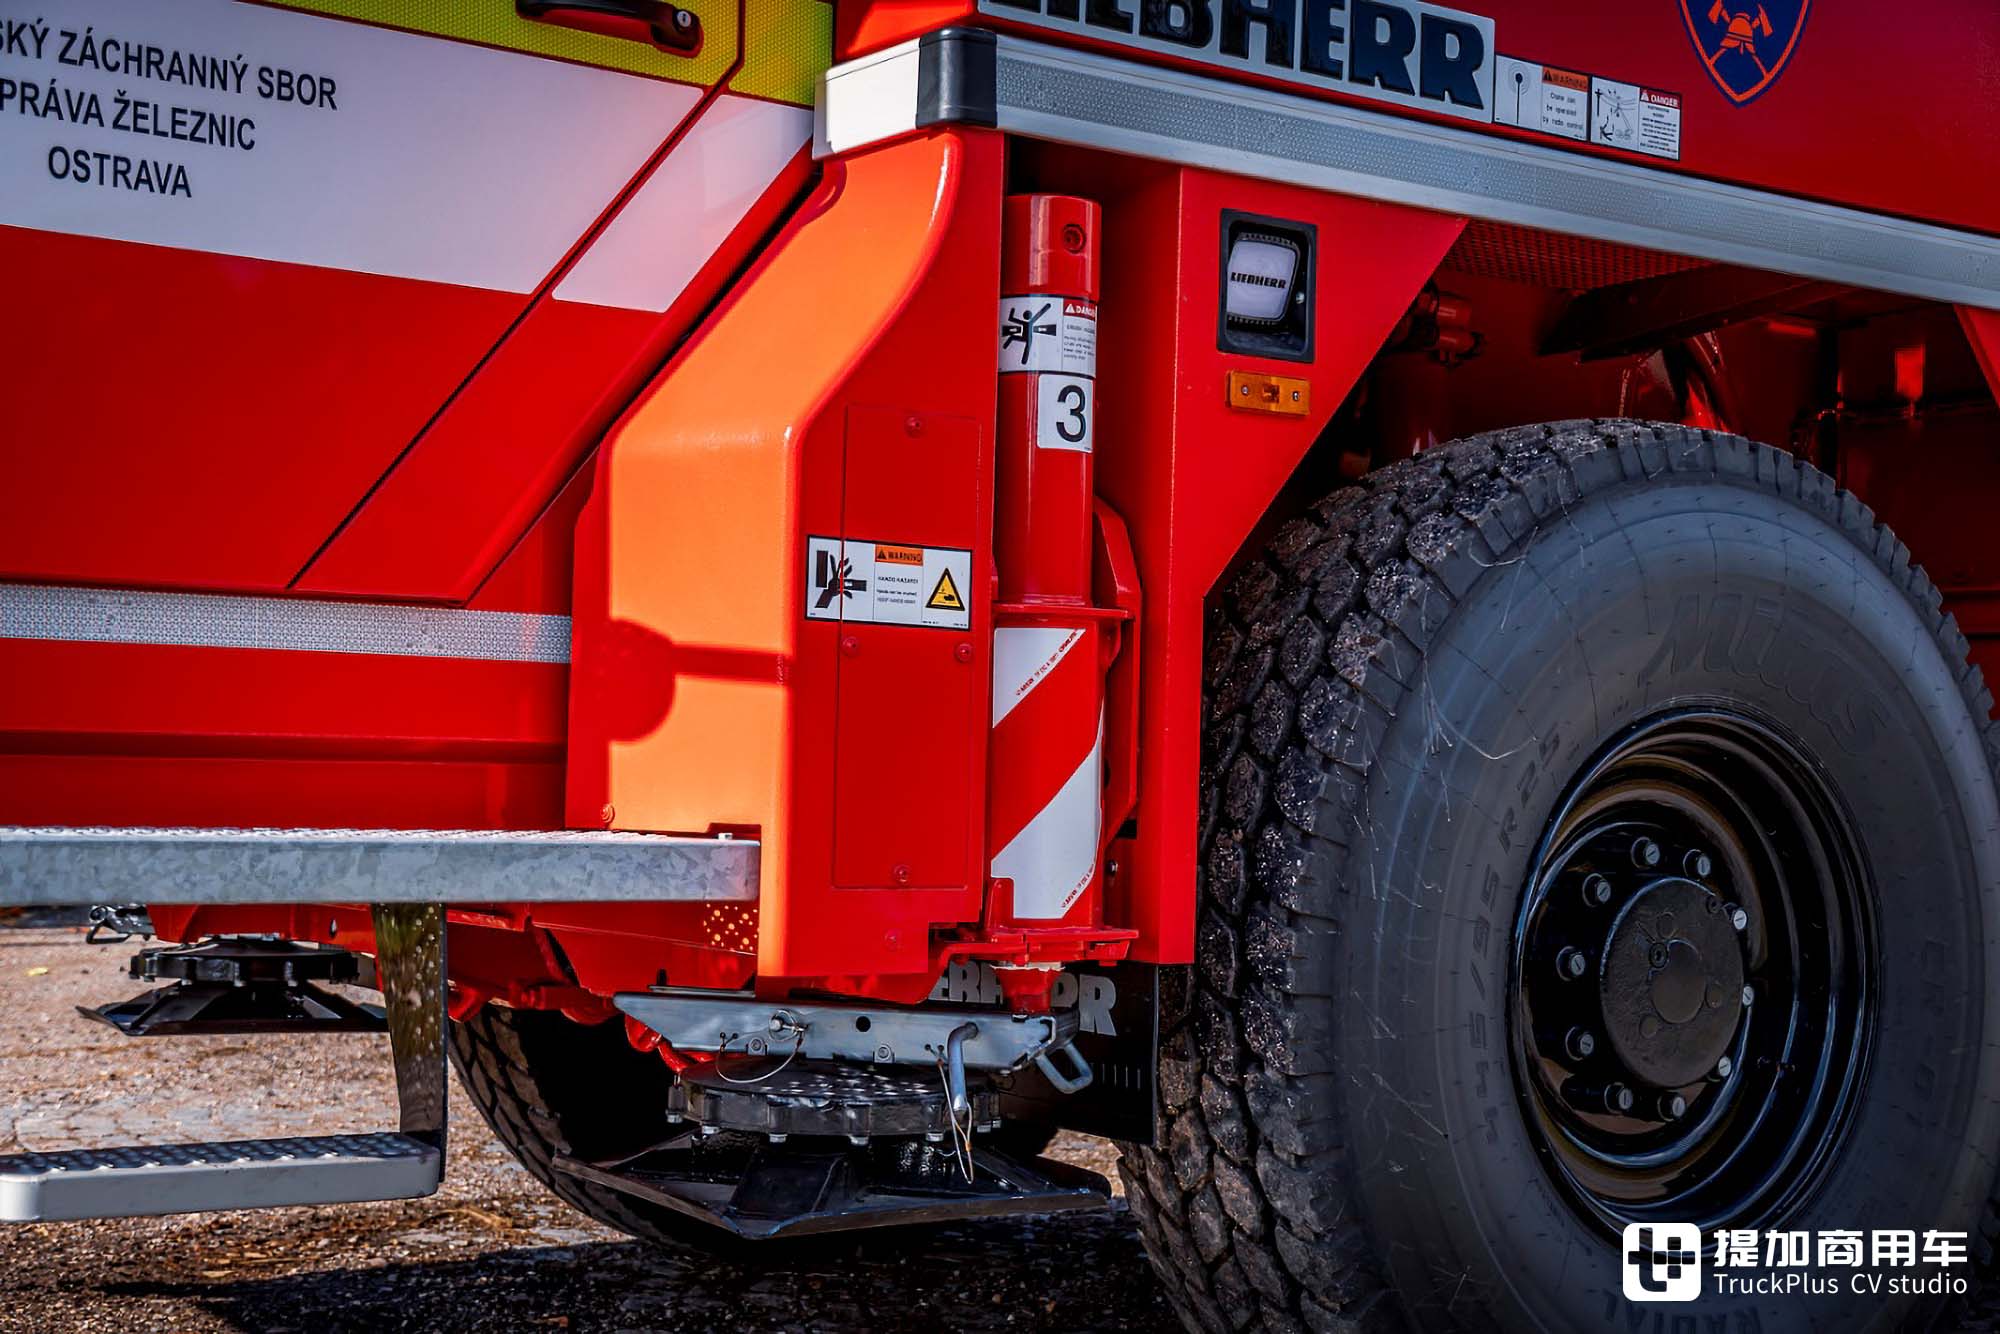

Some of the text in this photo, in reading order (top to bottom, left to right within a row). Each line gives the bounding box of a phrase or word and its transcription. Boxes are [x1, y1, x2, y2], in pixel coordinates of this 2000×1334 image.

[0, 18, 338, 111] KÝ ZÁCHRANNÝ SBOR
[986, 0, 1485, 110] BHERR
[112, 89, 256, 151] ŽELEZNIC
[1650, 94, 1679, 107] DANGER
[48, 146, 192, 198] OSTRAVA
[1230, 271, 1287, 290] LIEBHERR
[1056, 384, 1087, 443] 3
[887, 551, 922, 563] WARNING
